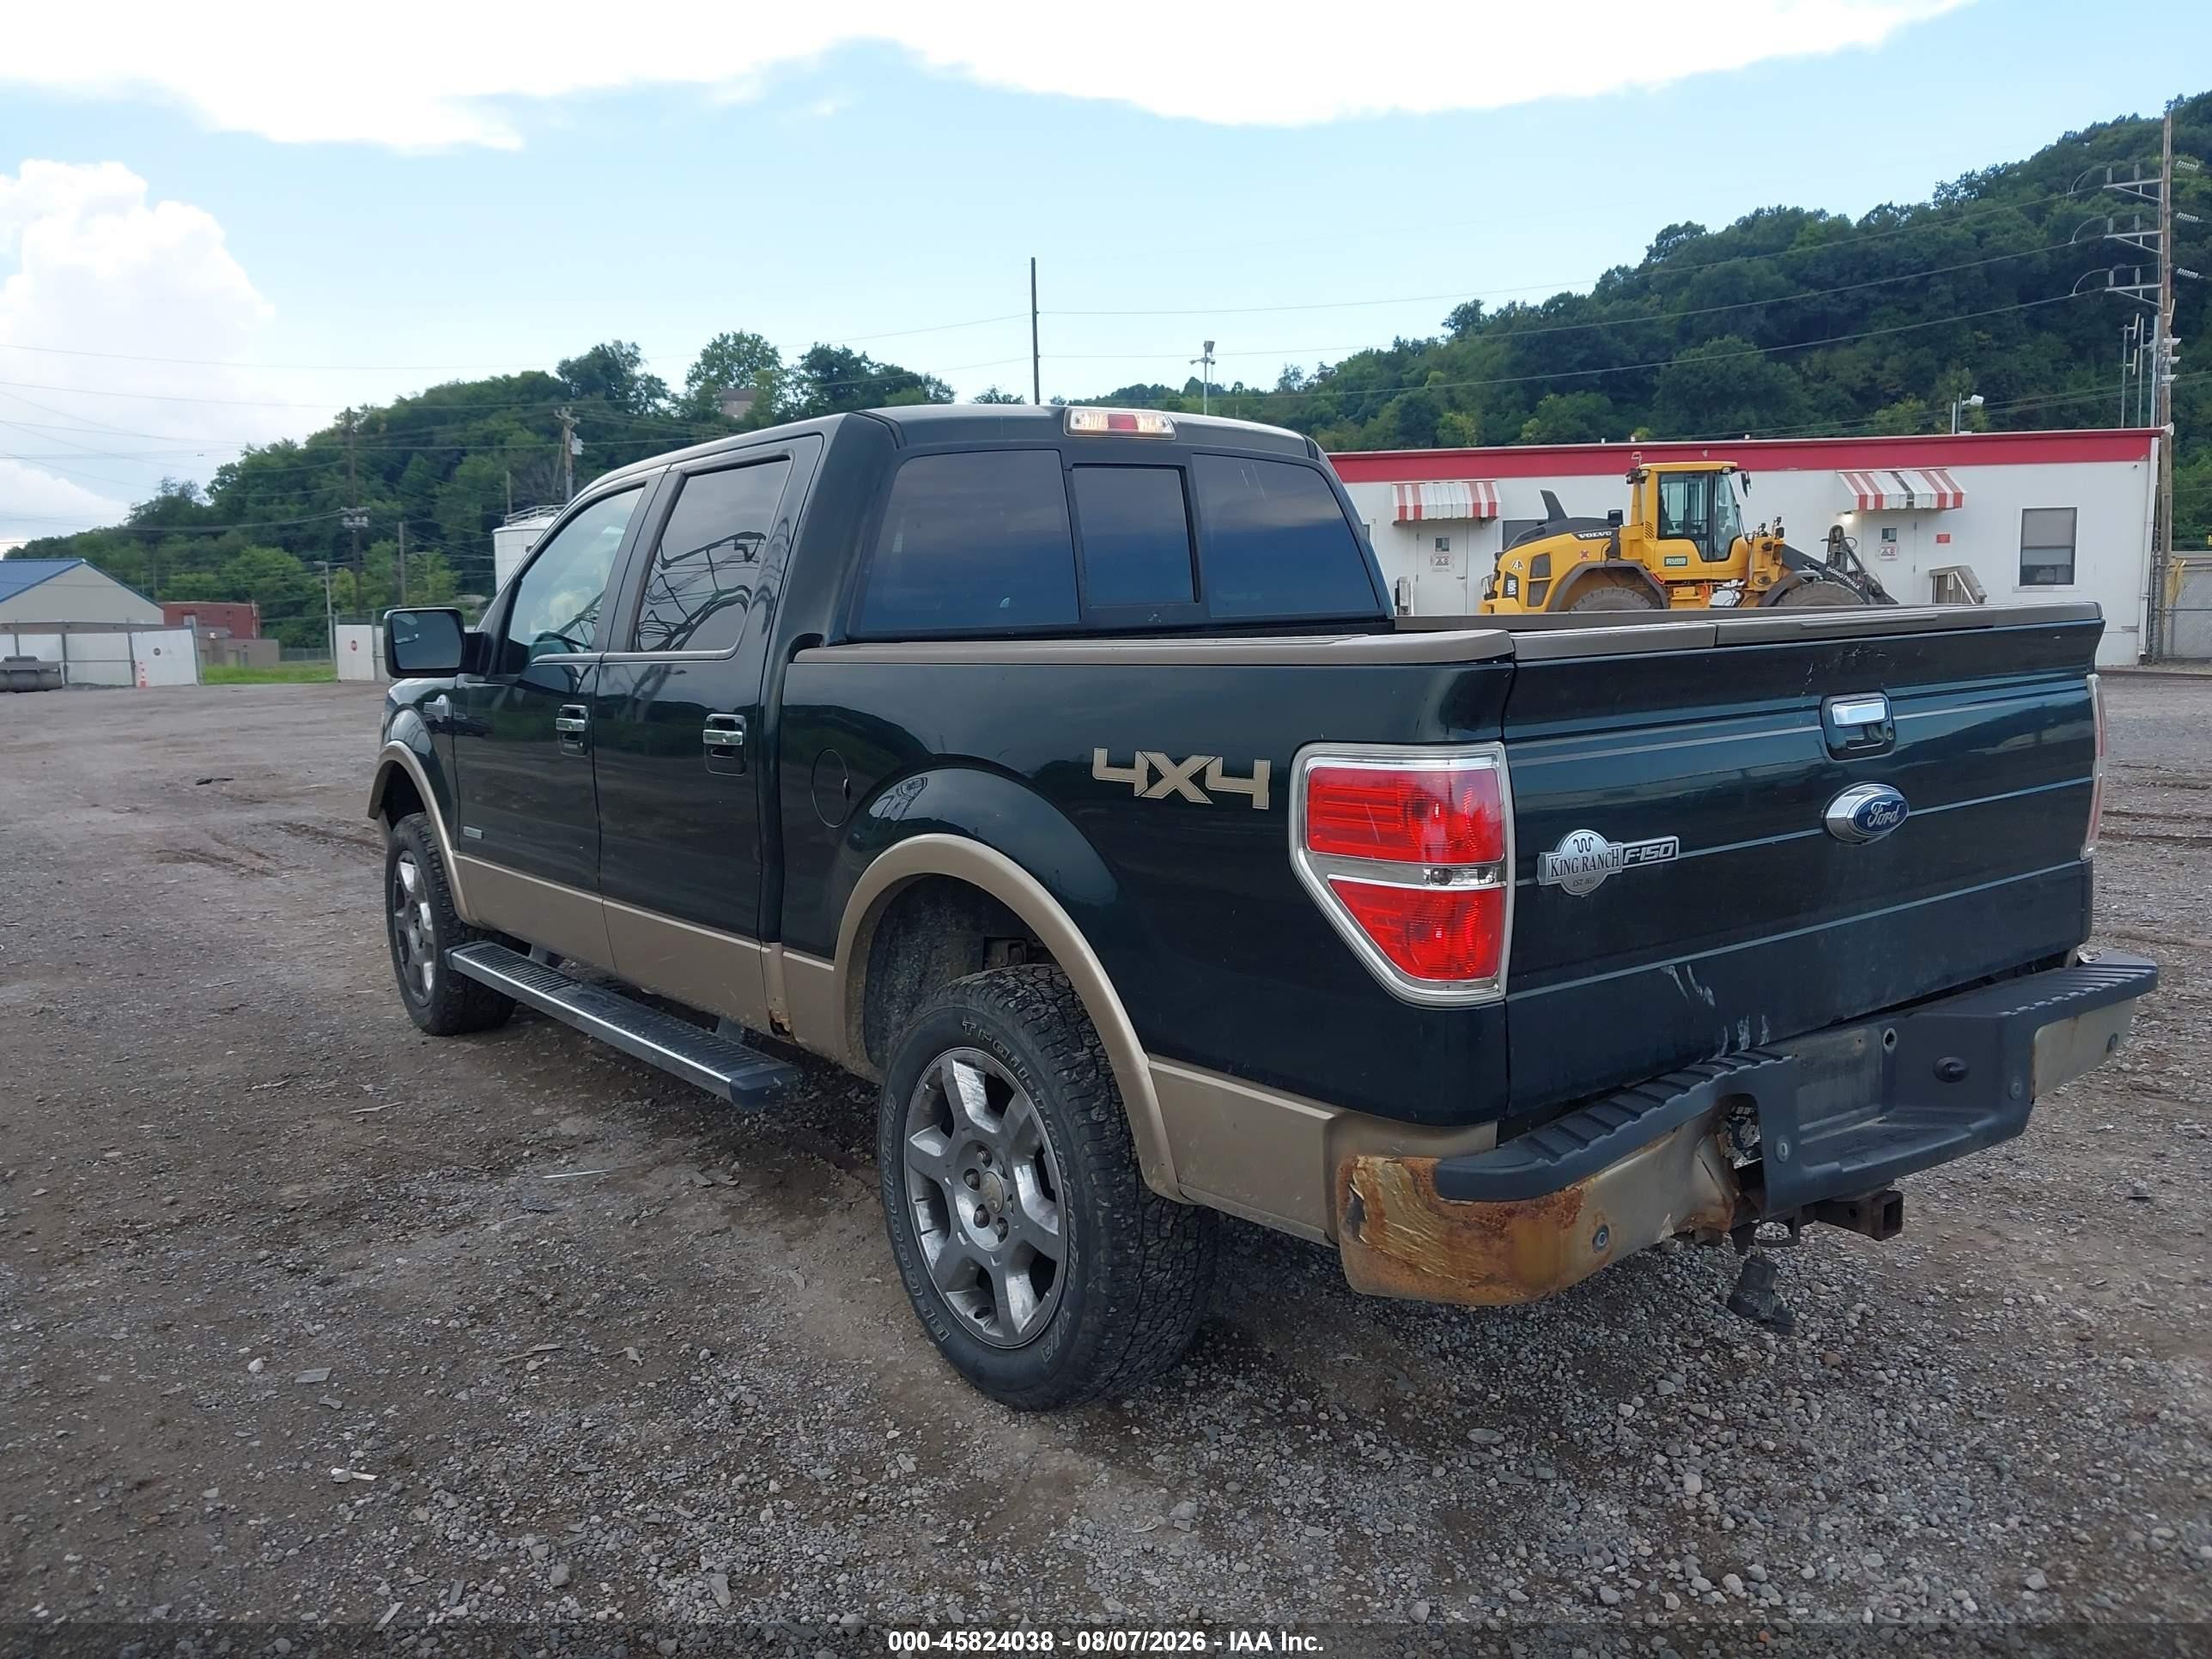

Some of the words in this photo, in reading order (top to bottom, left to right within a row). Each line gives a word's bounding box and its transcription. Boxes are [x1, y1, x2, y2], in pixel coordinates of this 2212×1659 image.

[1577, 531, 1613, 539] VOLVO
[1867, 800, 1905, 828] Ford
[1551, 857, 1580, 878] KING
[1582, 848, 1620, 872] RANCH
[1624, 842, 1675, 864] F-150
